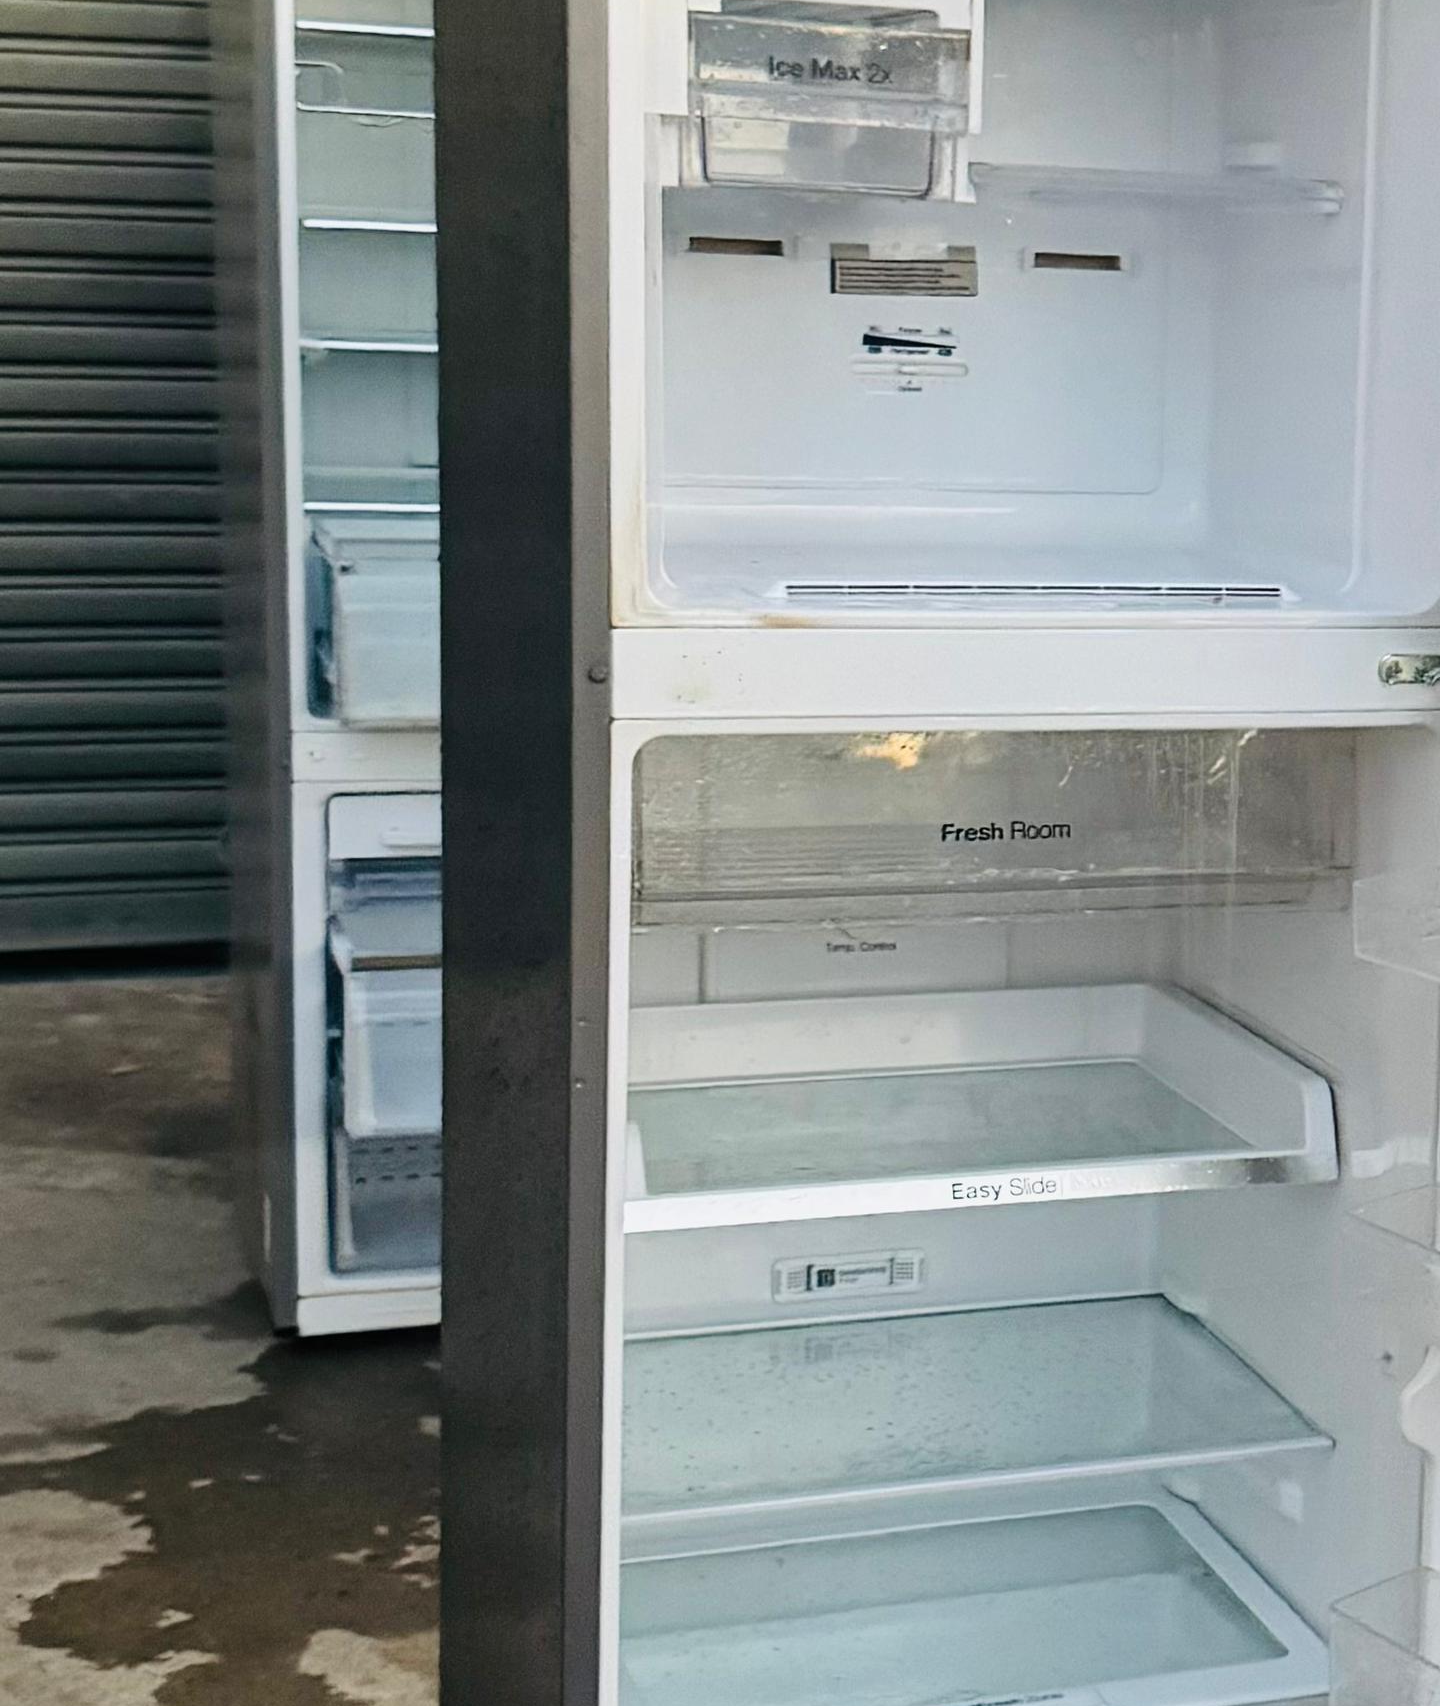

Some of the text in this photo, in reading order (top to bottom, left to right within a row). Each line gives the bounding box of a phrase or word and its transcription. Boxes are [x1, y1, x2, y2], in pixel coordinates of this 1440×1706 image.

[768, 54, 893, 84] Ice Max 2x
[941, 820, 1072, 842] Fresh Room
[951, 1182, 1002, 1201] Easy
[1008, 1176, 1058, 1197] Slide
